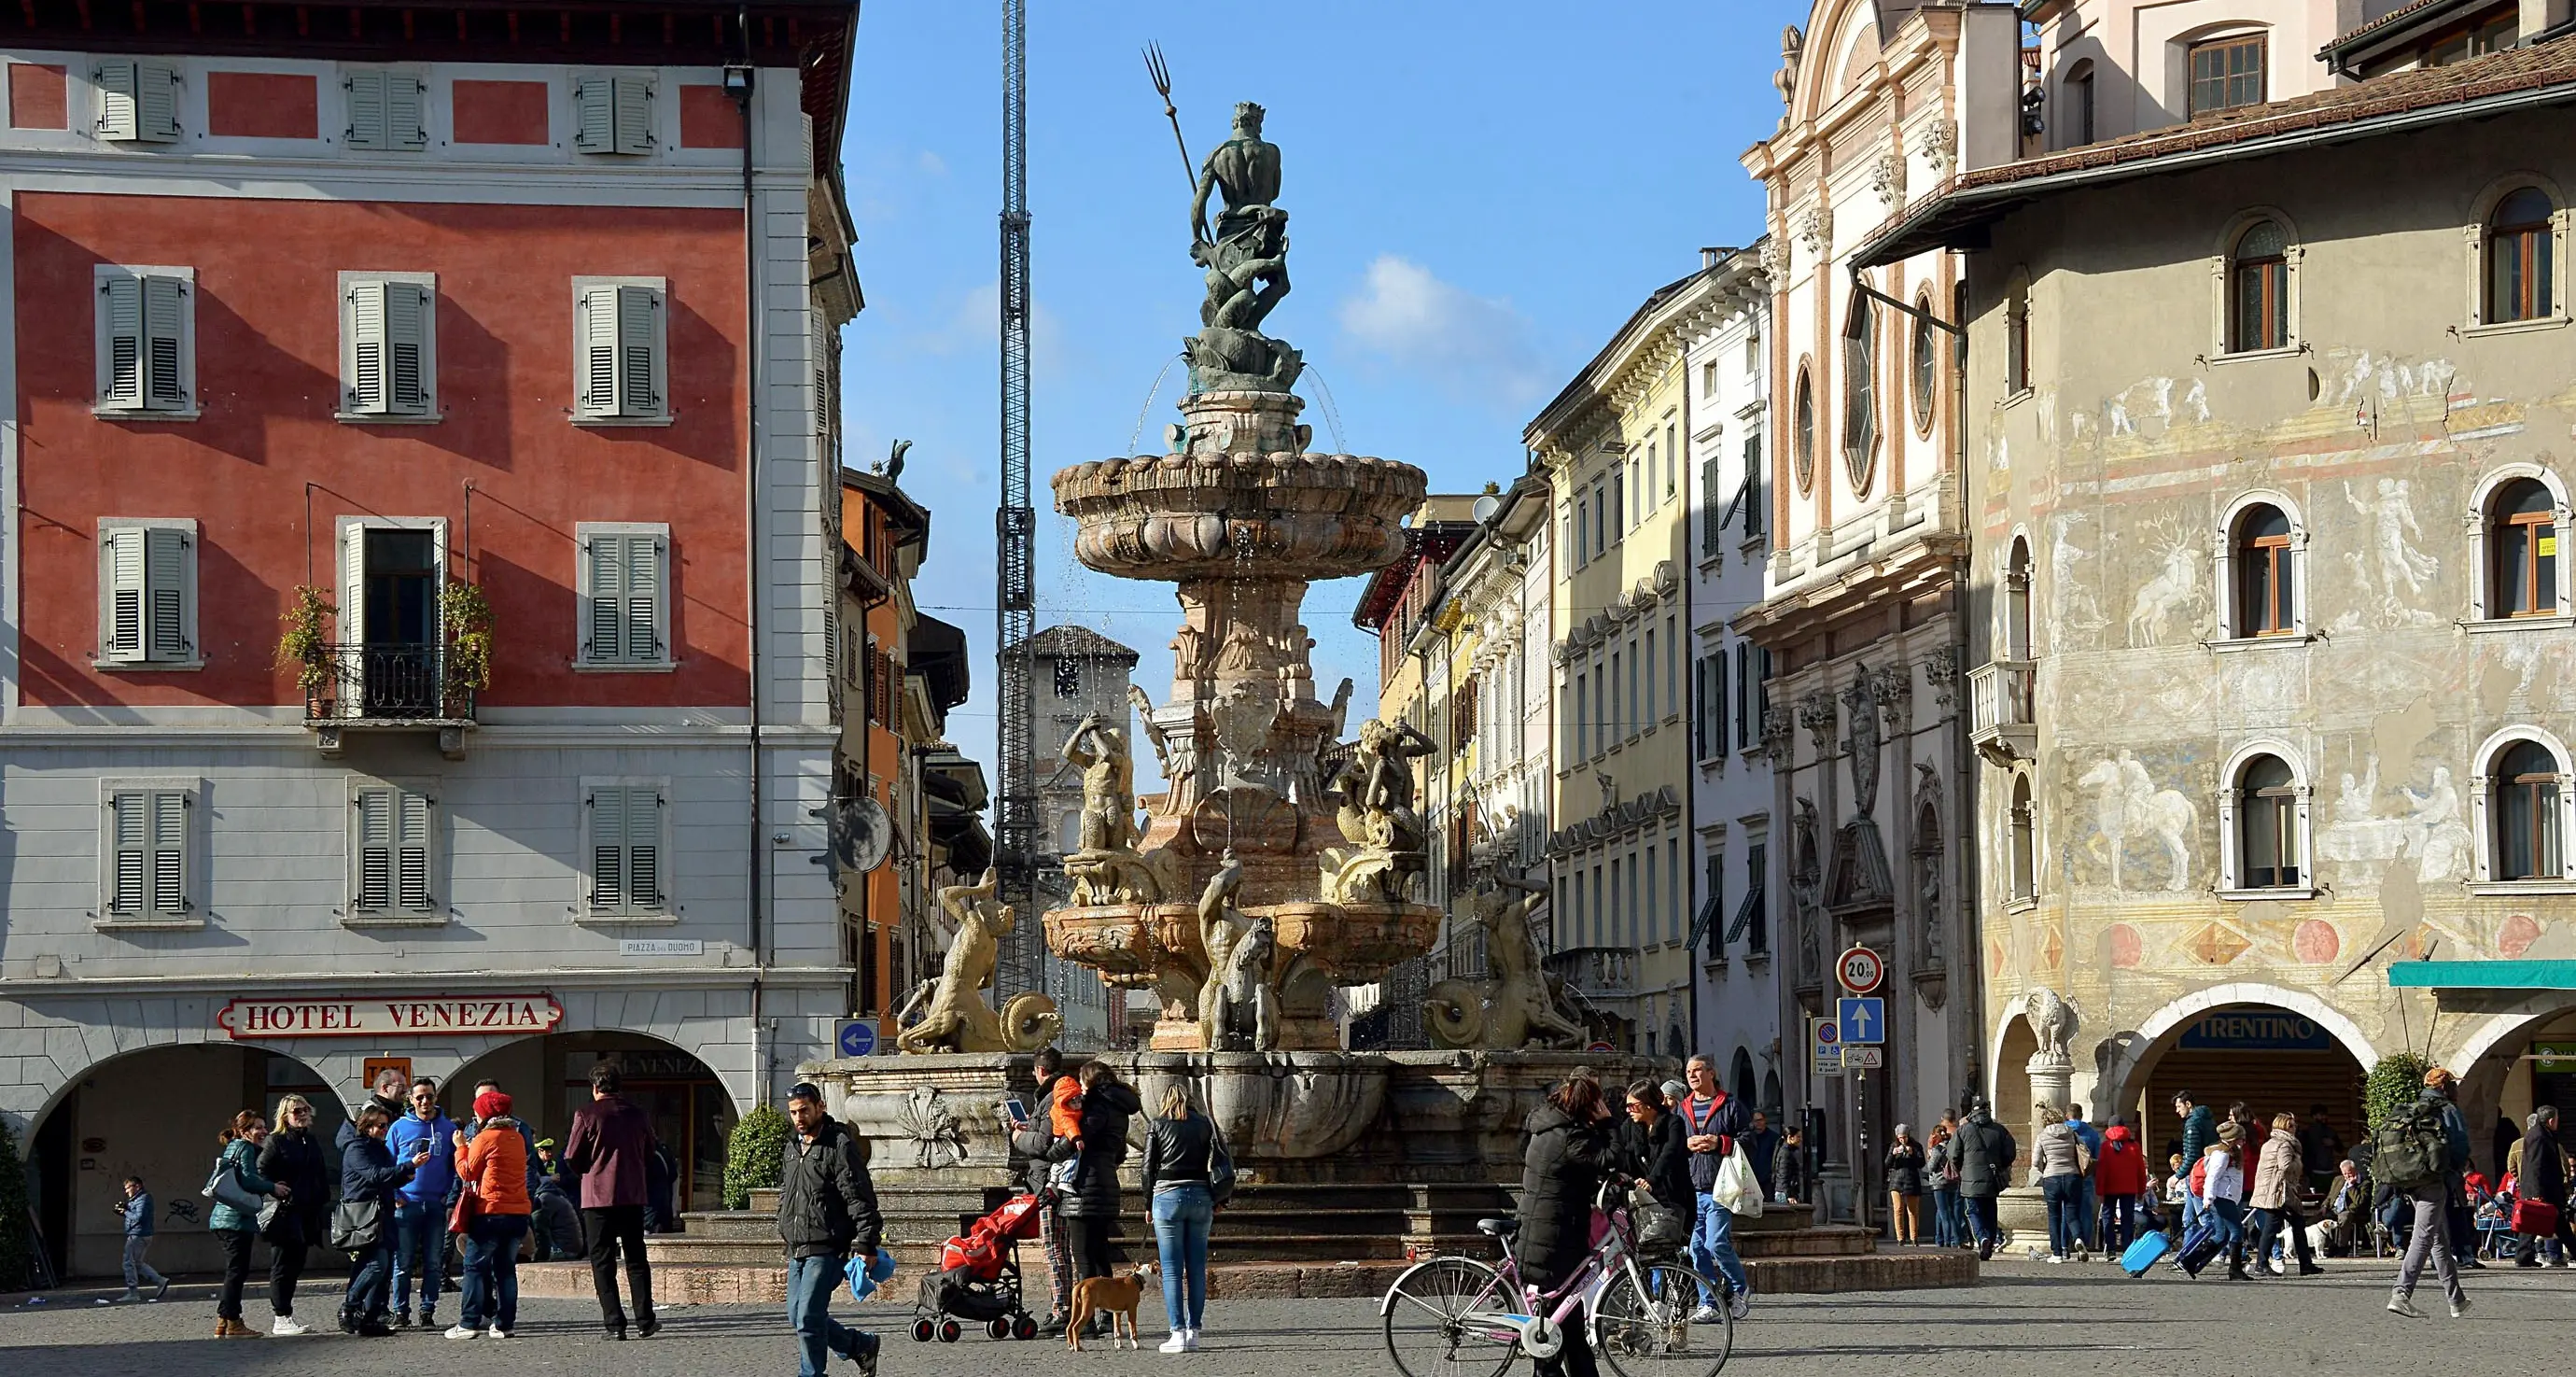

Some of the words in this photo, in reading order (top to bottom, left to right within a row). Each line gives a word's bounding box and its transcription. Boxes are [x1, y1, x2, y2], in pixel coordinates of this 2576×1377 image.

[628, 943, 655, 952] PIAZZA
[668, 942, 694, 951] DUOMO
[246, 1005, 362, 1031] HOTEL
[385, 1002, 539, 1028] VENEZIA
[2198, 1017, 2316, 1040] TRENTINO
[638, 1057, 709, 1074] VENEZI
